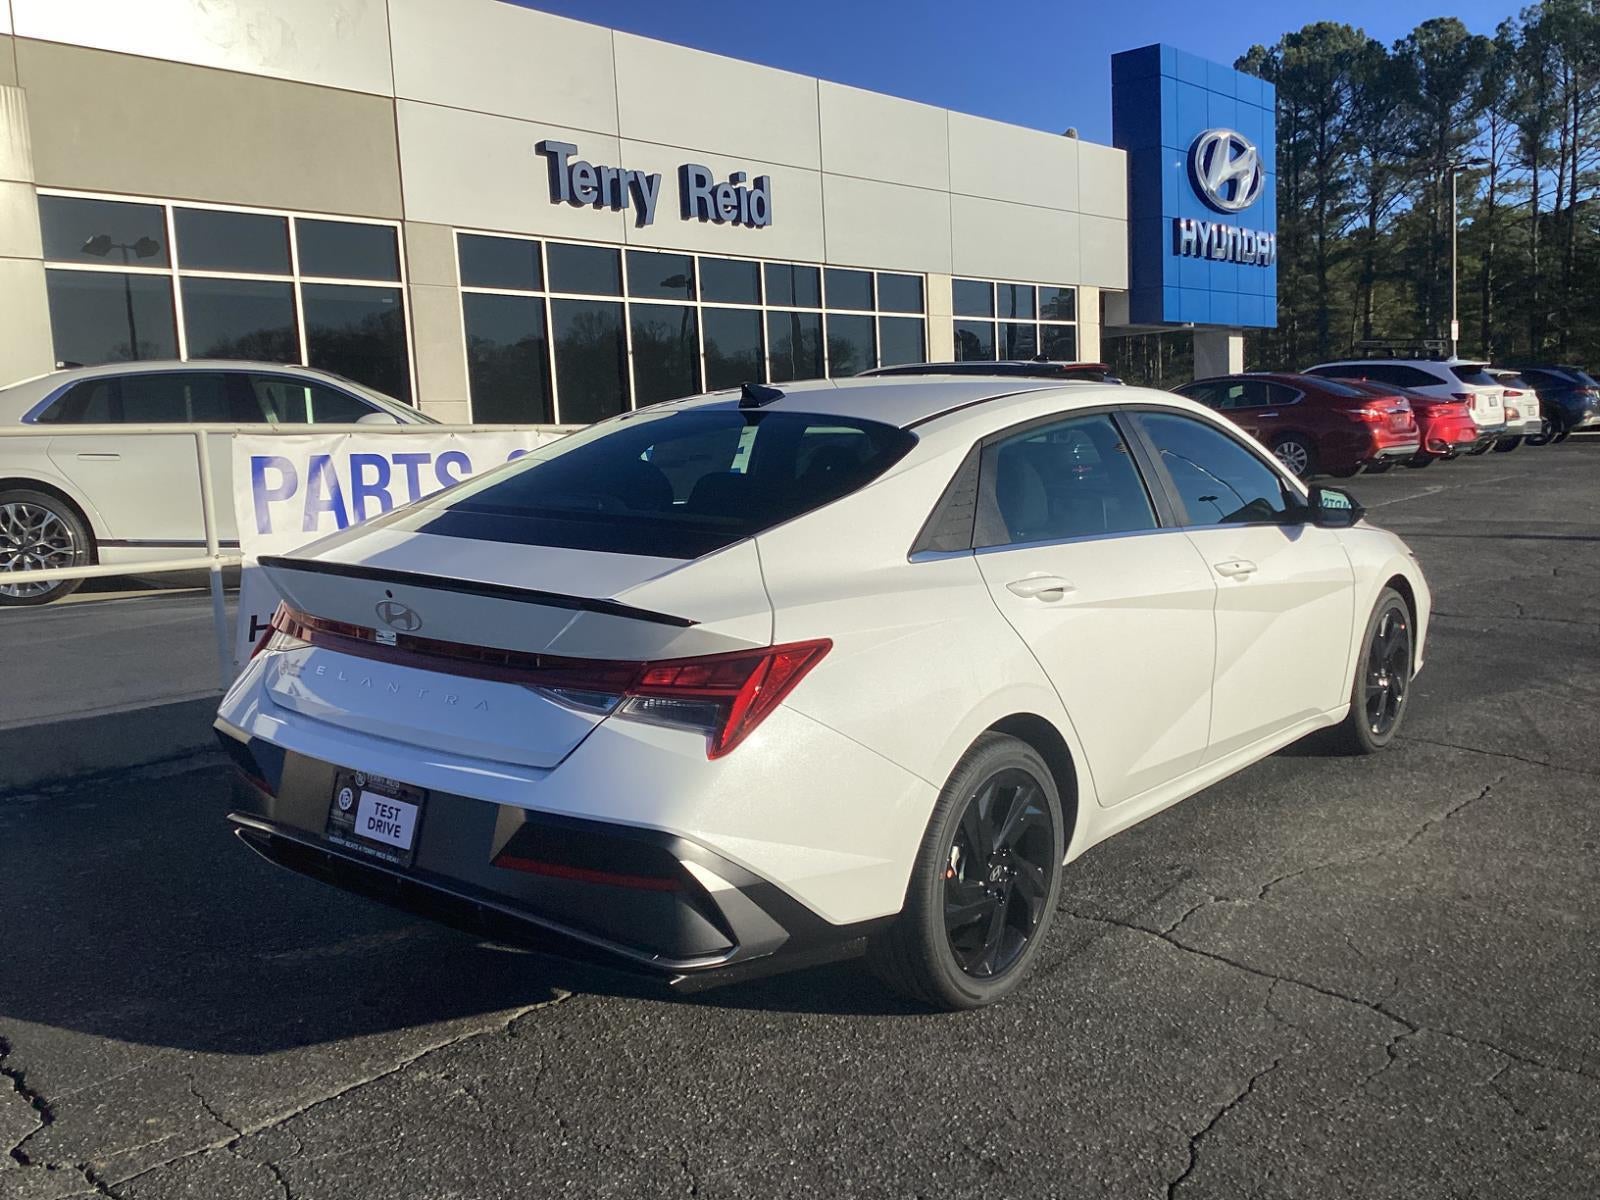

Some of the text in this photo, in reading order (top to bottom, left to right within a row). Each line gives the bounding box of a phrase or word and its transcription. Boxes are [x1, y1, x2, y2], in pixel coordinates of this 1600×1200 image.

[535, 140, 772, 228] Terry Reid
[1173, 217, 1276, 266] HYUNDAI
[315, 665, 489, 711] ELANTRA
[367, 817, 401, 838] DRIVE
[374, 802, 401, 821] TEST
